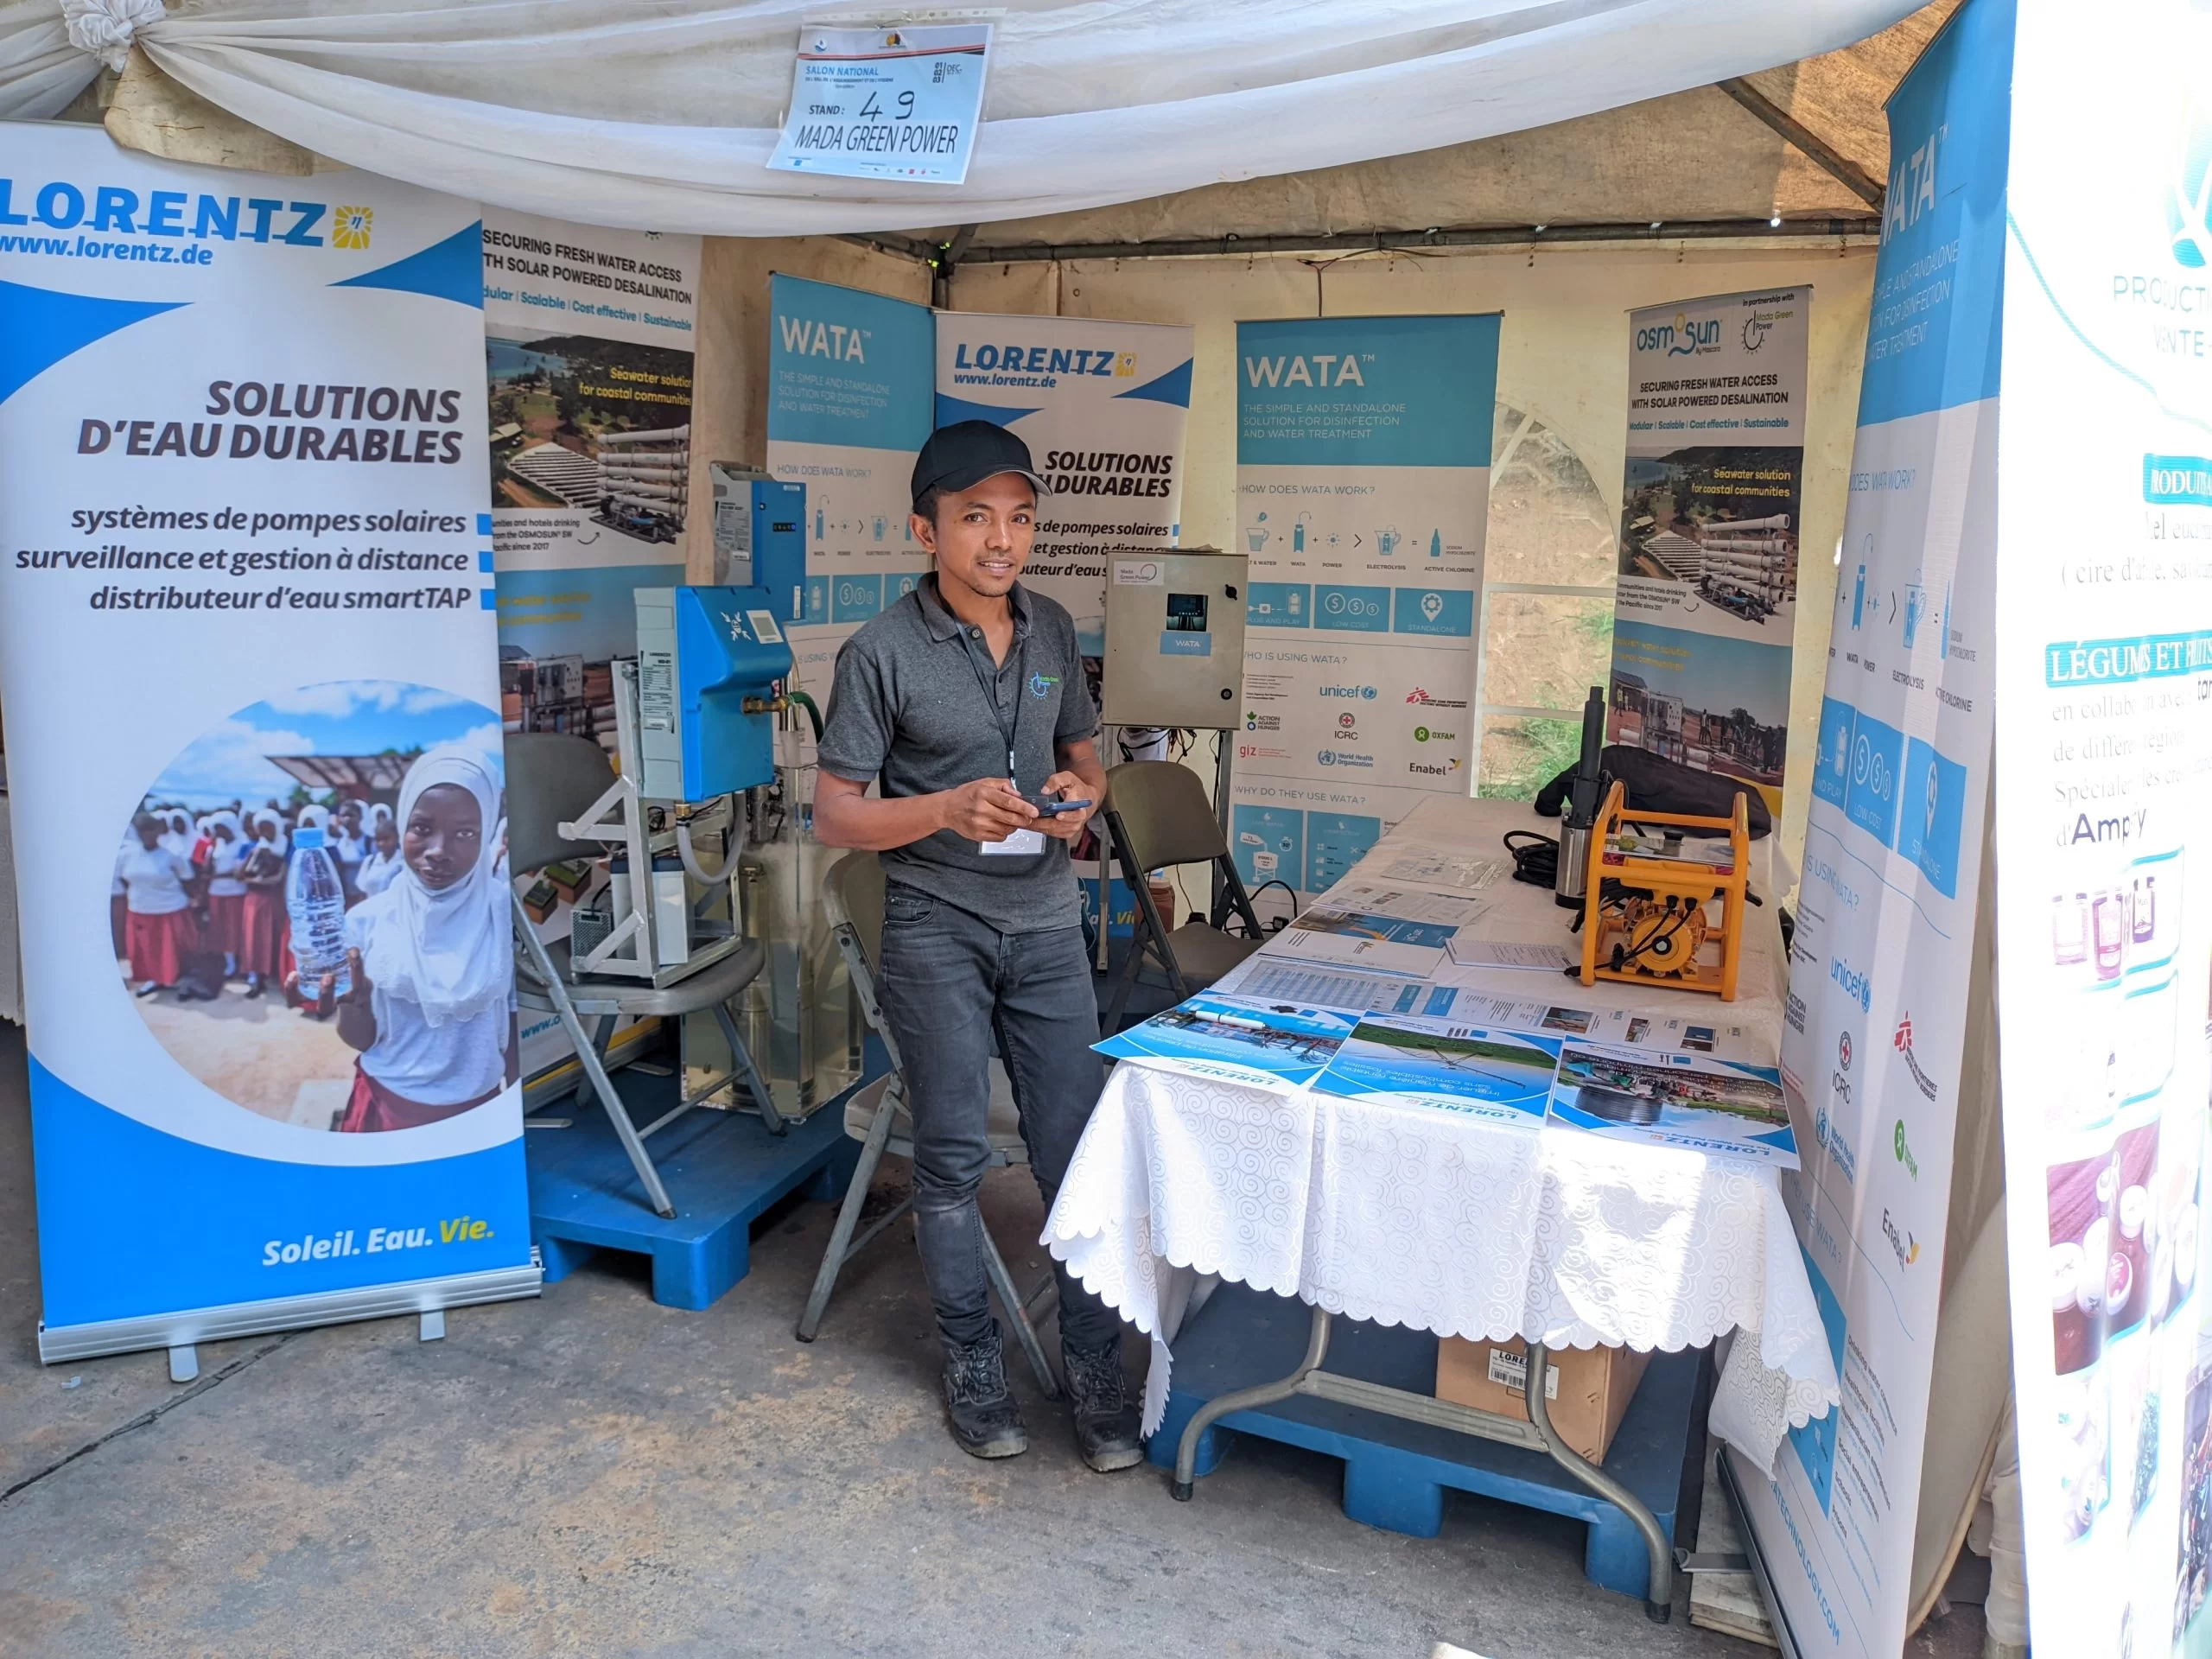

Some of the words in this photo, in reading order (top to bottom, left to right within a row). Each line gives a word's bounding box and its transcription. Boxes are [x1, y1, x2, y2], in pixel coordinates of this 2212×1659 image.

[805, 66, 835, 75] SALON
[836, 67, 879, 76] NATIONAL
[795, 125, 842, 149] MADA
[847, 125, 899, 152] GREEN
[899, 125, 958, 154] POWER
[0, 178, 327, 247] LORENTZ
[0, 234, 213, 265] www.lorentz.de
[482, 230, 551, 256] SECURING
[555, 244, 594, 264] FRESH
[597, 253, 636, 273] WATER
[639, 263, 682, 283] ACCESS
[482, 252, 504, 270] TH
[507, 257, 550, 278] SOLAR
[552, 268, 613, 289] POWERED
[614, 279, 692, 304] DESALINATION
[521, 292, 566, 310] Scalable
[572, 302, 595, 315] Cost
[596, 305, 637, 322] effective
[1748, 296, 1780, 307] partnership
[1782, 293, 1795, 302] with
[1775, 310, 1793, 320] Green
[955, 343, 1115, 378] LORENTZ
[610, 366, 659, 385] Seawater
[954, 372, 1058, 389] www.lorentz.de
[1640, 380, 1680, 392] SECURING
[1681, 378, 1707, 390] FRESH
[1709, 377, 1739, 389] WATER
[1741, 374, 1778, 386] ACCESS
[578, 383, 594, 395] for
[596, 386, 632, 400] coastal
[1631, 397, 1649, 409] WITH
[1650, 397, 1677, 409] SOLAR
[1678, 394, 1719, 407] POWERED
[1720, 391, 1789, 405] DESALINATION
[206, 381, 461, 423] SOLUTIONS
[1244, 404, 1262, 413] THE
[1266, 404, 1302, 413] SIMPLE
[1306, 404, 1329, 413] AND
[1332, 404, 1406, 413] STANDALONE
[1243, 416, 1295, 425] SOLUTION
[1299, 416, 1320, 425] FOR
[1323, 416, 1400, 425] DISINFECTION
[1658, 419, 1685, 429] Scalable
[1689, 419, 1706, 429] Cost
[1707, 418, 1739, 429] effective
[1744, 417, 1789, 429] Sustainable
[77, 419, 226, 459] D'EAU
[230, 426, 464, 464] DURABLES
[1243, 429, 1264, 438] AND
[1268, 429, 1304, 438] WATER
[1309, 429, 1372, 438] TREATMENT
[778, 464, 799, 474] HOW
[1045, 450, 1173, 475] SOLUTIONS
[1713, 468, 1754, 480] Seawater
[1755, 469, 1791, 480] solution
[1054, 474, 1173, 498] DURABLES
[1242, 485, 1266, 493] HOW
[1268, 485, 1298, 493] DOES
[1301, 486, 1332, 494] WATA
[1692, 483, 1702, 493] for
[1703, 483, 1733, 495] coastal
[1735, 485, 1790, 497] communities
[71, 505, 209, 535] systèmes
[213, 508, 248, 530] de
[251, 513, 361, 537] pompes
[365, 510, 467, 533] solaires
[1043, 520, 1060, 533] de
[1061, 523, 1115, 537] pompes
[1116, 522, 1169, 537] solaires
[1033, 543, 1048, 555] et
[1047, 542, 1098, 558] gestion
[16, 545, 197, 570] surveillance
[199, 550, 226, 569] et
[230, 548, 332, 576] gestion
[338, 548, 353, 570] à
[357, 545, 469, 571] distance
[1064, 563, 1100, 577] d'eau
[90, 586, 263, 610] distributeur
[265, 588, 345, 610] d'eau
[344, 588, 471, 610] smartTAP
[1408, 624, 1456, 633] STANDALONE
[1278, 653, 1308, 662] USING
[1319, 684, 1360, 698] unicef
[1334, 730, 1358, 741] ICRC
[1432, 731, 1455, 741] OXFAM
[1240, 744, 1256, 759] giz
[1338, 759, 1374, 768] Organization
[1409, 762, 1446, 776] Enabel
[1235, 785, 1257, 795] WHY
[1261, 787, 1276, 797] DO
[1278, 789, 1303, 798] THEY
[1306, 791, 1326, 801] USE
[1831, 956, 1862, 1001] unicef
[1833, 1069, 1852, 1104] ICRC
[1420, 1102, 1518, 1121] LORENTZ
[1665, 1135, 1770, 1156] LORENTZ
[262, 1230, 361, 1267] Soleil.
[366, 1226, 434, 1254] Eau.
[439, 1215, 495, 1244] Vie.
[1882, 1207, 1905, 1272] Enabel
[1499, 1351, 1529, 1365] LORE
